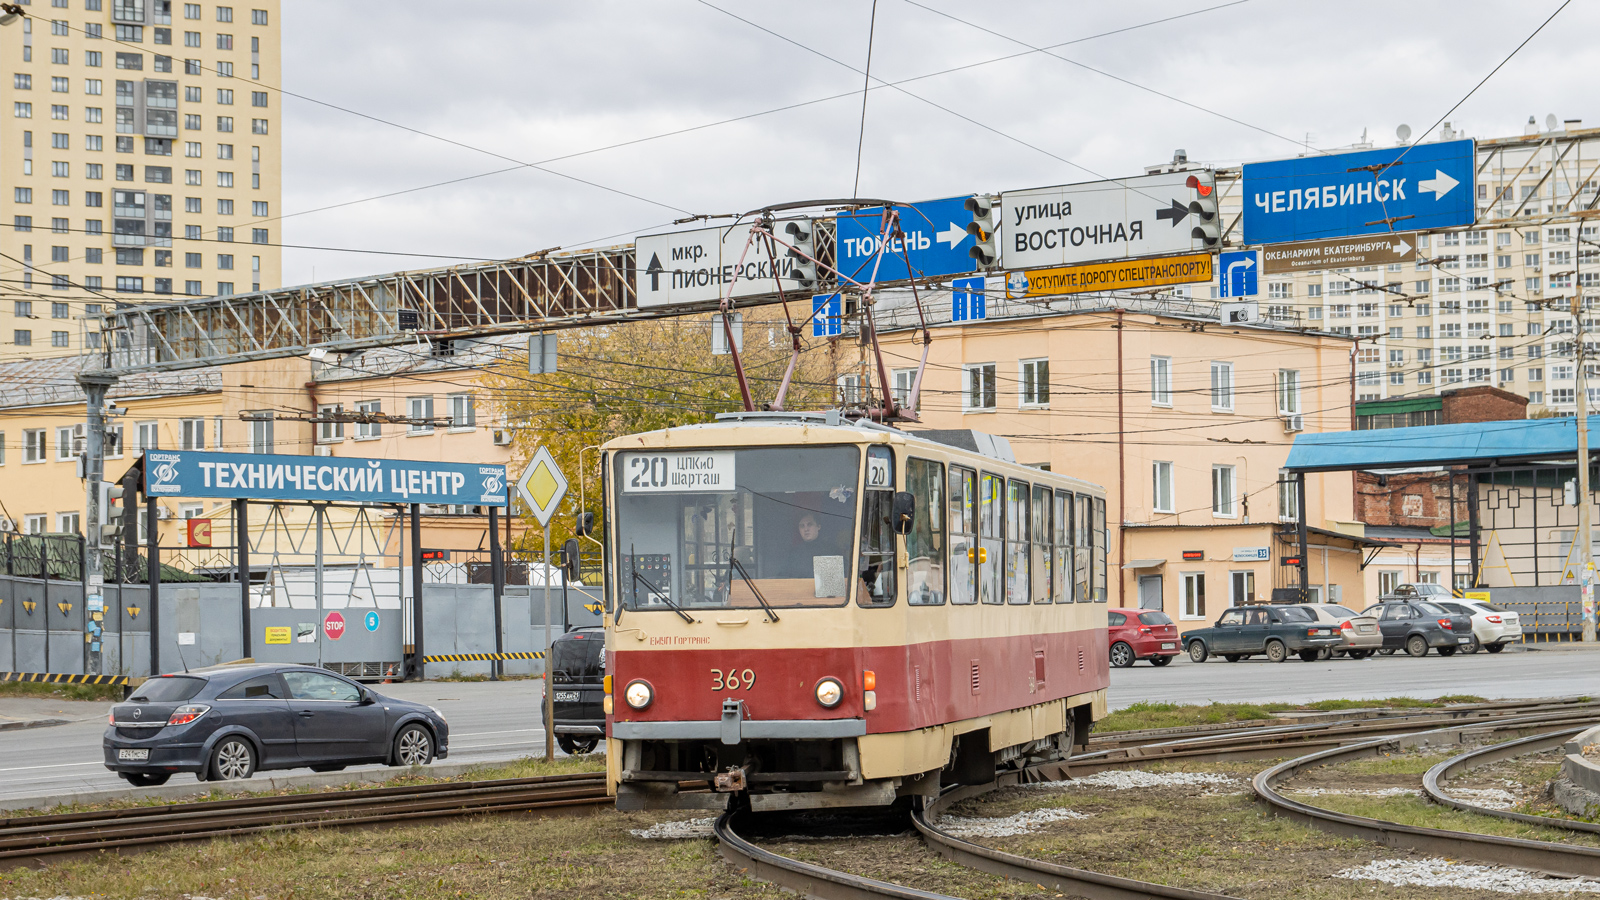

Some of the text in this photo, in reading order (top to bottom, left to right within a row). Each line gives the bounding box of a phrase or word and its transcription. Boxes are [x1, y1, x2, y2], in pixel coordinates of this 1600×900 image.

[1255, 178, 1406, 213] ЧЕЛЯБИНСК
[1014, 201, 1072, 226] улица
[843, 230, 931, 258] ТЮМЕНЬ
[1015, 220, 1143, 252] ВОСТОЧНАЯ
[672, 244, 708, 263] мкр.
[1265, 241, 1392, 261] ОКЕАНАРИУМ ЕКАТЕРИНБУРГА
[1291, 258, 1322, 267] Oceanarium
[1330, 255, 1365, 264] Ekaterinburg
[672, 253, 793, 289] ПИОНЕРСКИЙ
[1030, 261, 1210, 290] УСТУПИТЕ ДОРОГУ СПЕЦТРАНСПОРТУ!
[150, 453, 181, 462] ГОРТРАНС
[677, 456, 714, 470] ЦПКиО
[198, 461, 465, 498] ТЕХНИЧЕСКИЙ ЦЕНТР
[479, 467, 505, 475] ГОРТРАНС
[631, 457, 668, 488] 20
[671, 472, 720, 488] Шарташ
[871, 465, 885, 485] 20
[326, 621, 344, 631] STOP
[369, 617, 375, 627] 5
[710, 668, 756, 691] 369
